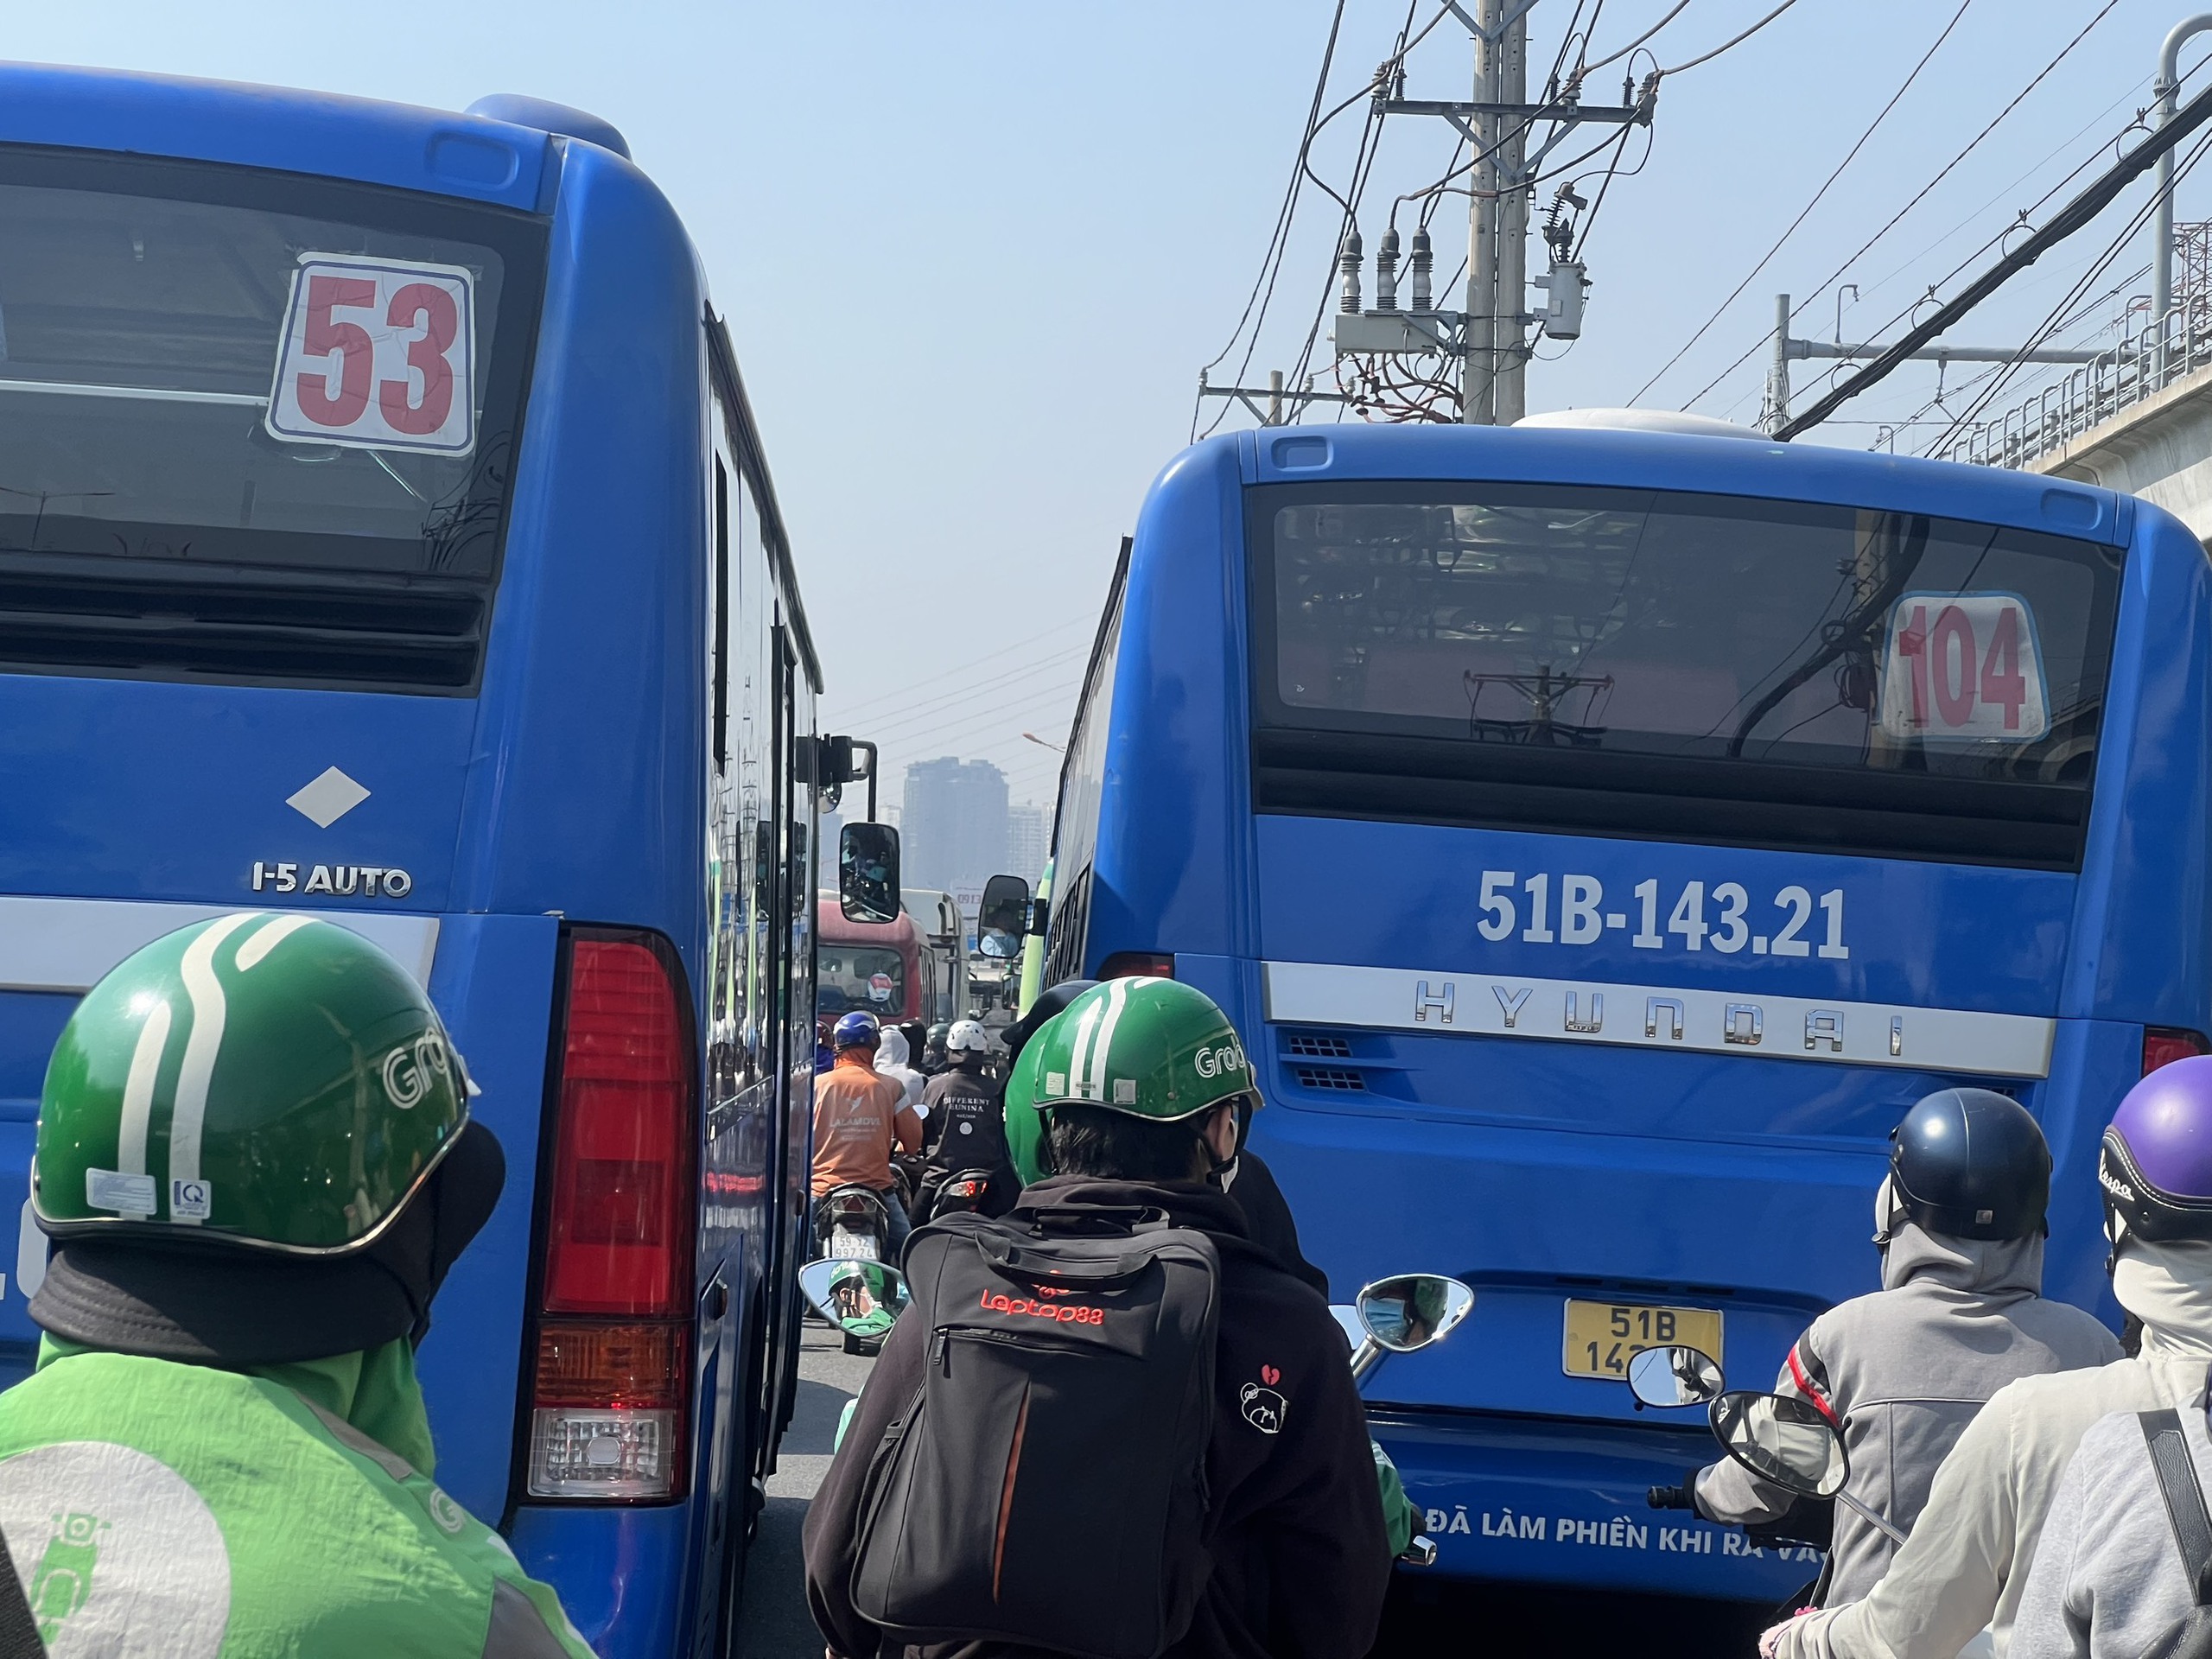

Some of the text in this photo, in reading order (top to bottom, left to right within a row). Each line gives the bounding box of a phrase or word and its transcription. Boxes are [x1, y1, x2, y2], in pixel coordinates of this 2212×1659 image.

[296, 275, 458, 435] 53
[1898, 605, 2025, 730] 104
[304, 865, 412, 899] AUTO
[1476, 869, 1850, 959] 51B-143.21
[1414, 980, 1904, 1057] HYUNDAI
[383, 1027, 448, 1109] Gra
[1194, 1034, 1246, 1078] Grab
[943, 1096, 990, 1106] DIFFERENT
[2098, 1147, 2135, 1202] Vespa
[980, 1288, 1104, 1326] Laptop88
[1611, 1307, 1676, 1342] 51B
[1586, 1340, 1646, 1374] 14
[1482, 1507, 1546, 1541] LÀM
[1556, 1515, 1648, 1549] PHIỀN
[1658, 1527, 1712, 1554] KHI
